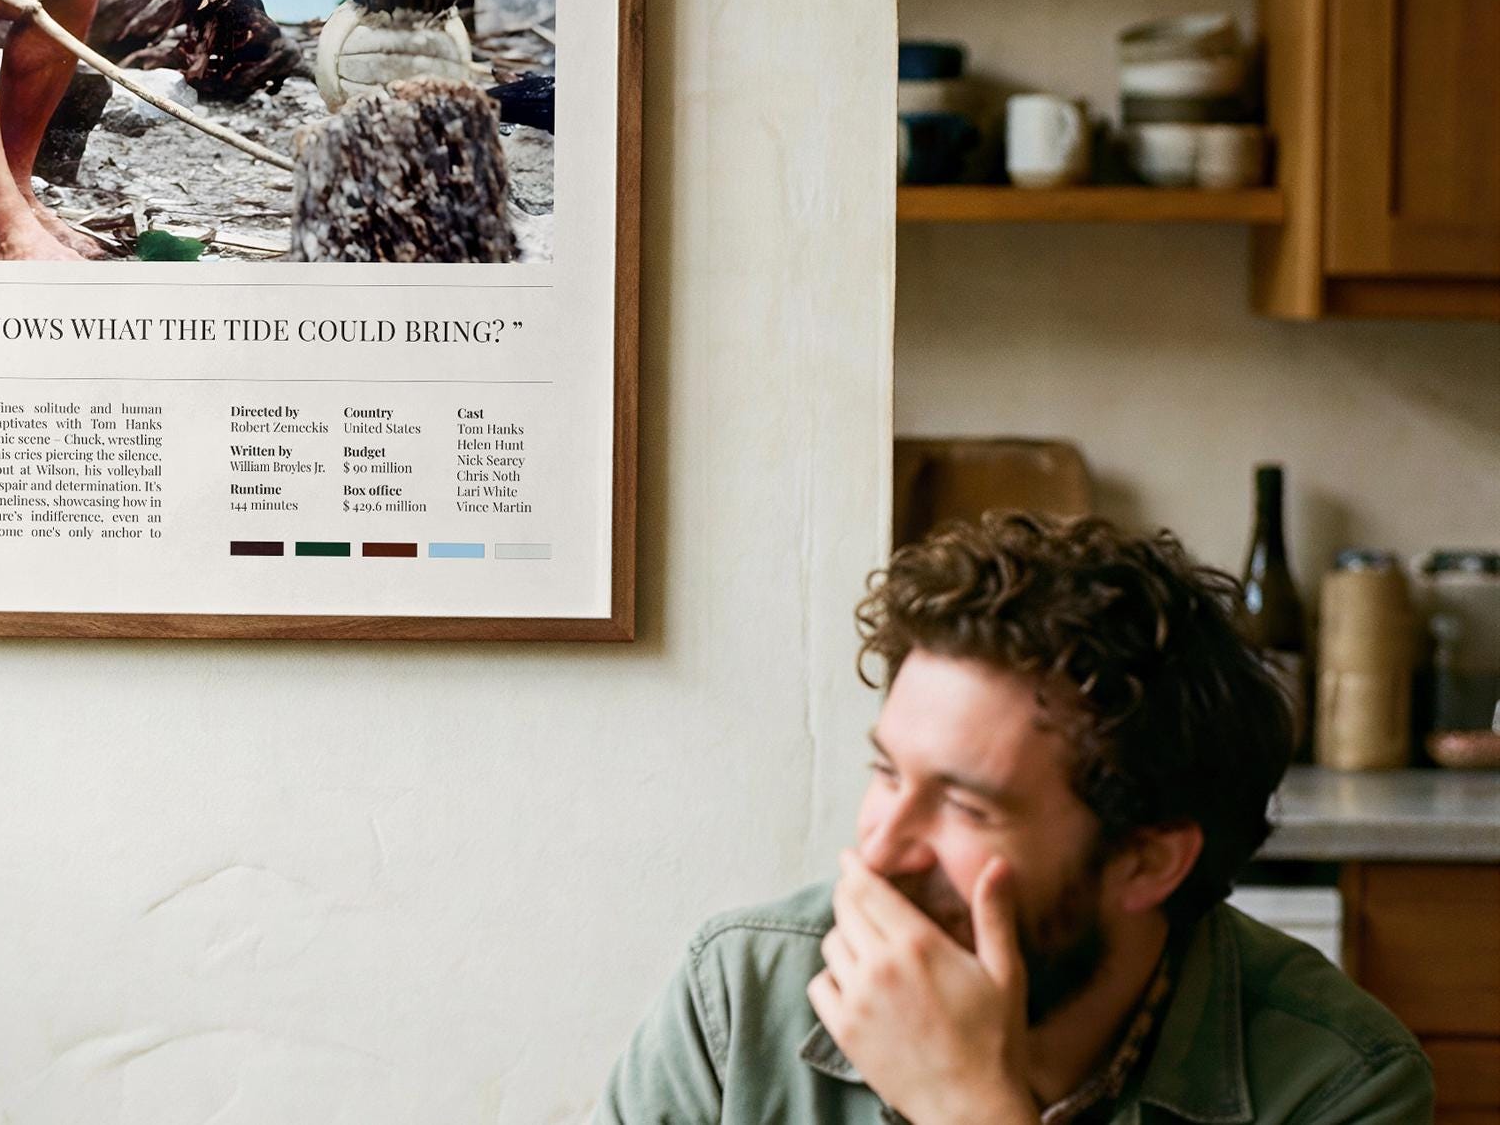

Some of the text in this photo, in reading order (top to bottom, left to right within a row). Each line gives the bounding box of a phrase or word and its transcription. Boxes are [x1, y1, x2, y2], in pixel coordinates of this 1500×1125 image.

[69, 317, 154, 341] WHAT
[158, 318, 216, 341] THE
[223, 318, 290, 342] TIDE
[297, 319, 396, 343] COULD
[404, 318, 506, 344] BRING?
[33, 401, 81, 415] solitude
[89, 402, 112, 415] and
[121, 402, 163, 415] human
[230, 405, 300, 421] Directed by
[343, 406, 394, 421] Country
[456, 407, 485, 420] Cast
[55, 417, 83, 430] with
[90, 418, 117, 430] Tom
[125, 418, 163, 431] Hanks
[230, 420, 329, 434] Robert Zemeckis
[343, 421, 422, 435] United States
[456, 422, 525, 436] Tom Hanks
[17, 435, 51, 446] scene
[107, 433, 163, 449] wrestling
[457, 438, 525, 451] Helen Hunt
[13, 451, 43, 461] cries
[45, 448, 94, 463] piercing
[96, 448, 116, 462] the
[229, 444, 293, 460] Written by
[343, 445, 386, 460] Budget
[229, 460, 271, 473] William
[272, 460, 312, 475] Broyles
[342, 460, 413, 475] $ 90 million
[457, 453, 526, 469] Nick Searcy
[19, 464, 32, 476] at
[84, 464, 103, 477] his
[106, 464, 162, 479] volleyball
[456, 469, 521, 482] Chris Noth
[29, 479, 53, 492] and
[230, 482, 283, 496] Runtime
[343, 484, 403, 497] Box office
[456, 485, 518, 498] Lari White
[52, 494, 121, 510] showcasing
[122, 495, 148, 508] how
[149, 495, 162, 508] in
[230, 498, 299, 513] 144 minutes
[342, 499, 427, 514] $ 429.6 million
[456, 500, 533, 514] Vince Martin
[111, 514, 140, 523] even
[146, 514, 162, 524] an
[67, 525, 94, 541] only
[100, 526, 143, 539] anchor
[149, 527, 162, 539] to
